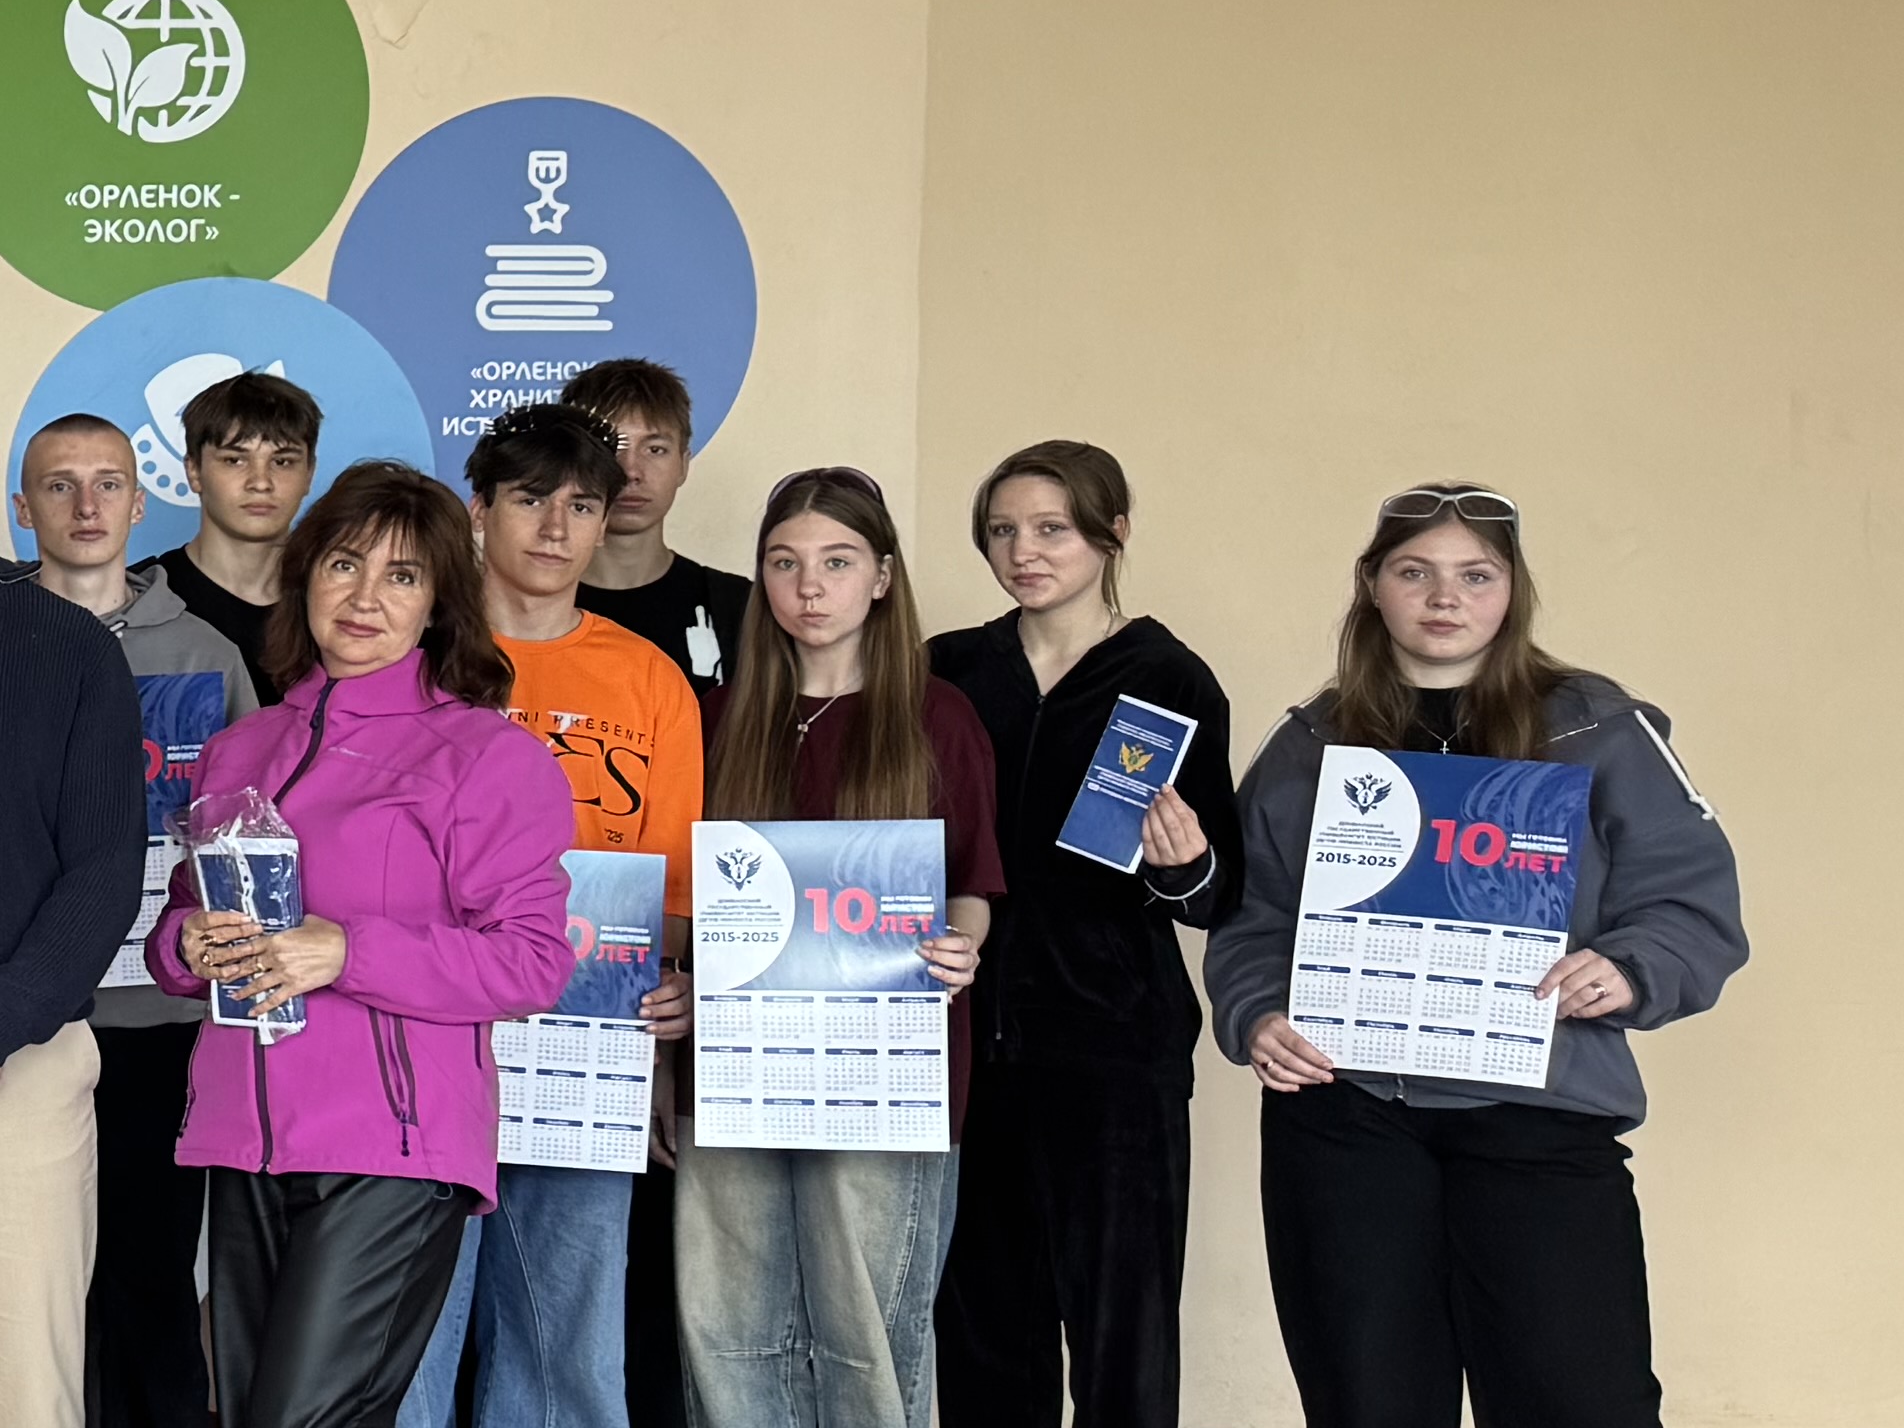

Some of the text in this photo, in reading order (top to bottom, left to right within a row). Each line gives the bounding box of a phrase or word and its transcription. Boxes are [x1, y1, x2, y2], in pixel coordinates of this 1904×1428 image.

[64, 184, 222, 209] «ОРЛЕНОК
[84, 218, 219, 243] ЭКОЛОГ»
[165, 763, 196, 780] ЛЕ
[1431, 818, 1508, 868] 10
[1315, 851, 1398, 868] 2015-2025
[1504, 851, 1567, 873] ЛЕТ
[804, 887, 877, 935] 10
[879, 914, 935, 935] ЛЕТ
[700, 931, 780, 943] 2015-2025
[595, 943, 651, 964] ЛЕТ
